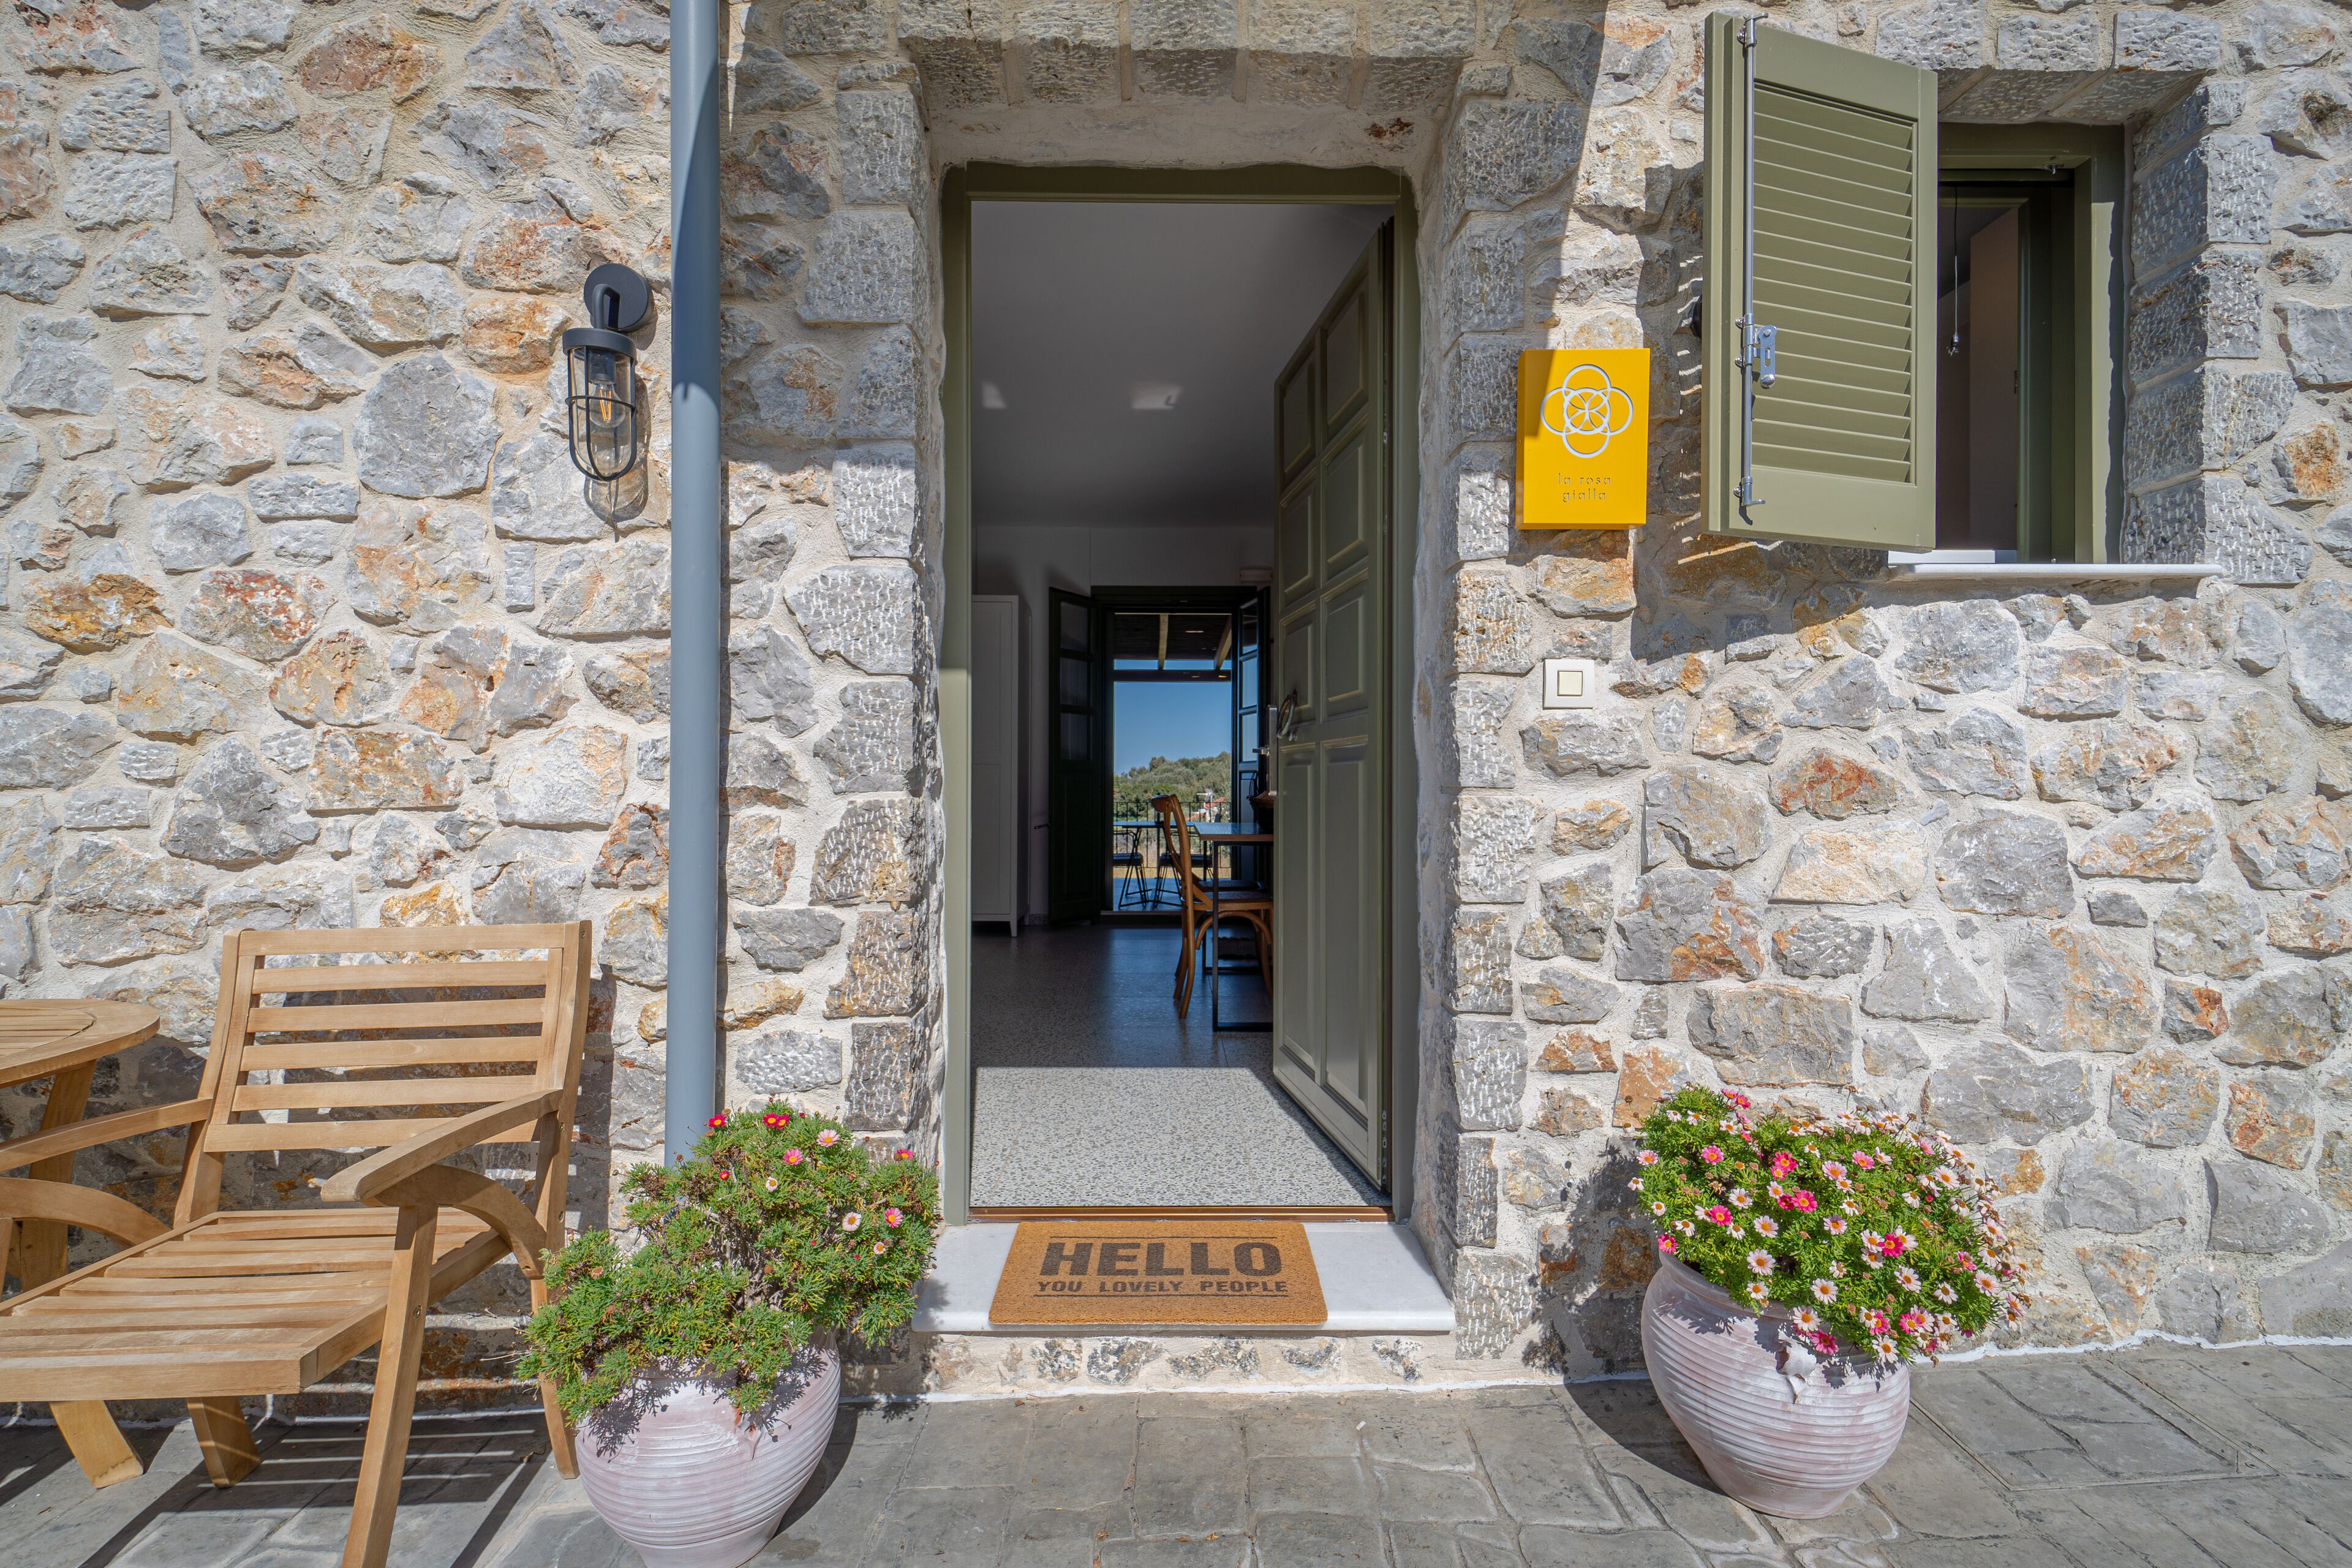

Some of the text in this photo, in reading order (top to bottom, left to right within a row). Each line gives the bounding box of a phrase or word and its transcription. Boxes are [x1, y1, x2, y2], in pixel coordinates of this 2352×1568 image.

[1558, 473, 1571, 484] la
[1562, 488, 1605, 502] gialla
[1039, 1242, 1282, 1276] HELLO
[1038, 1280, 1289, 1293] YOU LOVELY PEOPLE
